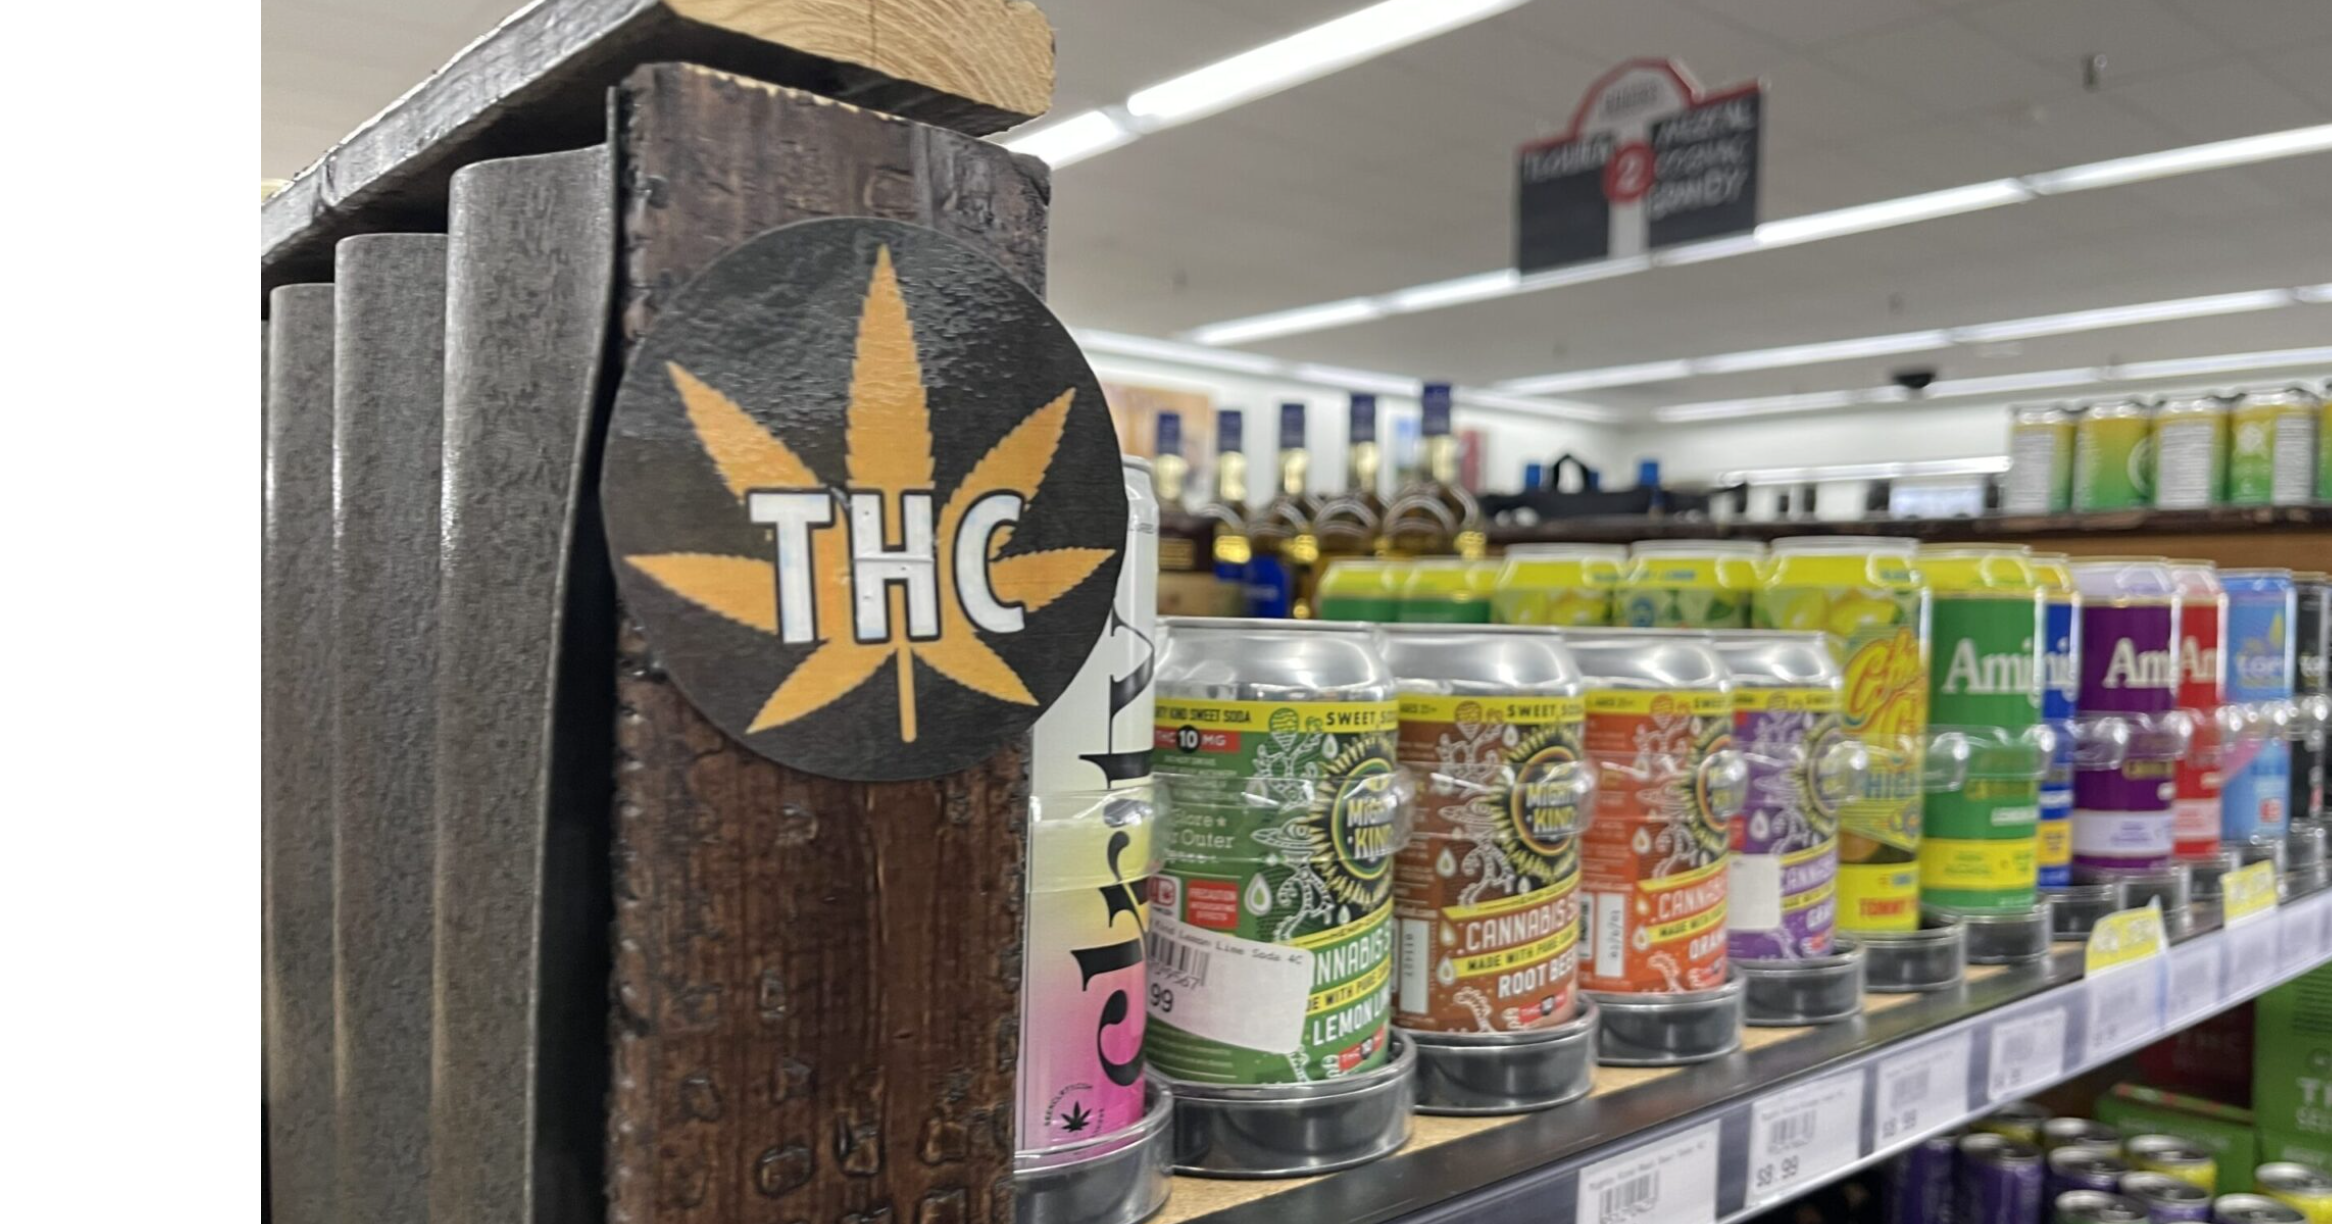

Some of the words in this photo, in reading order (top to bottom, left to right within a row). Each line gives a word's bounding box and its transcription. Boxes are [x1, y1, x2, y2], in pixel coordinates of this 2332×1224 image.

[1616, 152, 1643, 192] 2
[747, 488, 1027, 645] THC
[1325, 710, 1377, 727] SWEET
[1507, 704, 1556, 718] SWEET
[1178, 730, 1199, 748] 10
[1202, 734, 1227, 747] MG
[1181, 828, 1236, 850] Outer
[1466, 898, 1566, 951] CANNABIS
[1215, 940, 1245, 956] Lime
[1251, 948, 1282, 962] Soda
[1467, 954, 1502, 971] MADE
[1506, 949, 1534, 964] WITH
[1497, 962, 1549, 999] ROOT
[1325, 987, 1353, 1006] WITH
[1312, 998, 1374, 1047] LEMON
